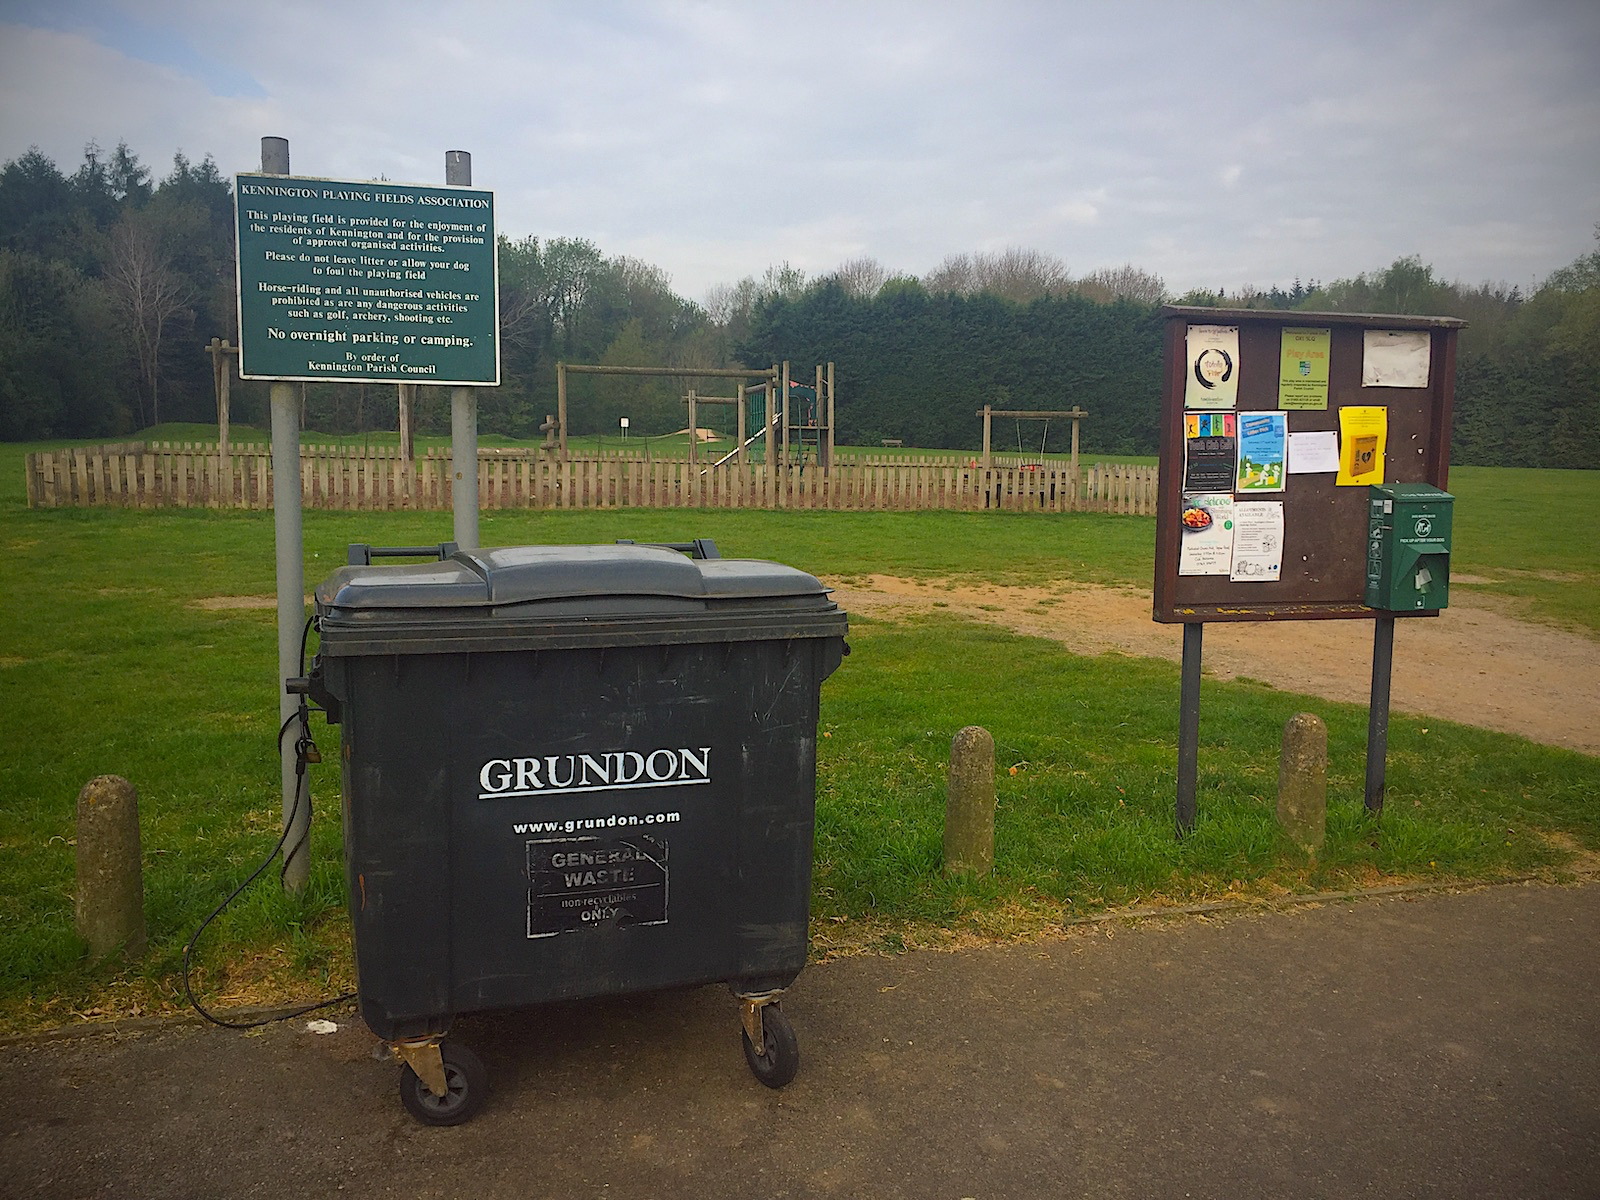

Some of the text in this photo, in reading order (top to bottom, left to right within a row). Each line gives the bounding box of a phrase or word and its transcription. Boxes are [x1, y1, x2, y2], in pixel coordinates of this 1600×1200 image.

[241, 185, 489, 208] KENNINGTON PLAYING FIELDS ASSOCIATION
[247, 210, 486, 232] This playing field is provided for the enjoyment of
[250, 224, 484, 244] the residents of Kennington and for the provision
[293, 236, 445, 253] of approved organised activities.
[265, 251, 470, 271] Please do not leave litter or allow your dog
[313, 266, 425, 280] to foul the playing field
[258, 282, 479, 301] Horse-riding and all unauthorised vehicles are
[272, 297, 320, 306] prohibited
[324, 299, 334, 307] as
[357, 300, 373, 309] any
[377, 300, 422, 311] dangerous
[426, 302, 468, 312] activities
[288, 309, 453, 324] such as golf, archery, shooting etc.
[268, 328, 473, 348] No overnight parking or camping.
[346, 352, 399, 362] By order of
[308, 361, 436, 374] Kennington Parish Council
[479, 748, 711, 792] GRUNDON
[513, 811, 680, 834] www.grundon.com
